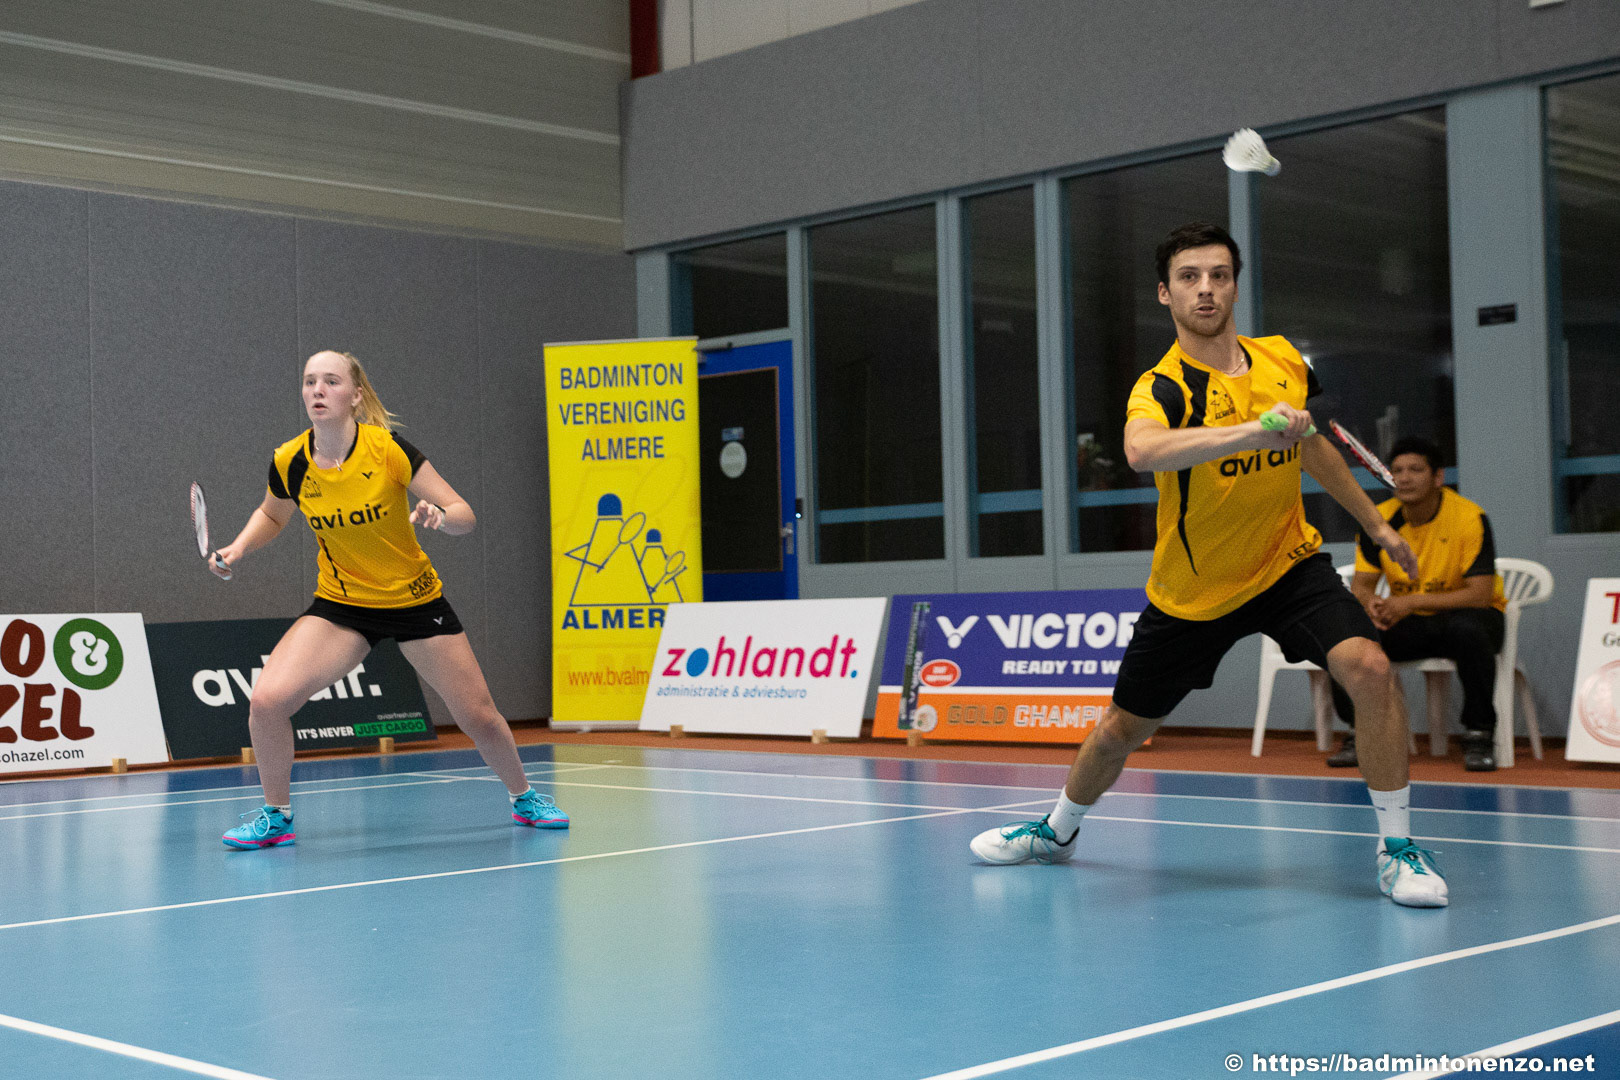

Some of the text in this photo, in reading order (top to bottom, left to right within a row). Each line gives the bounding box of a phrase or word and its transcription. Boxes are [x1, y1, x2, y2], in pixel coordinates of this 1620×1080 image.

[561, 363, 683, 389] BADMINTON
[559, 399, 685, 425] VERENIGING
[581, 436, 664, 461] ALMERE
[1220, 449, 1261, 477] avi
[309, 503, 388, 530] avi air.
[562, 608, 666, 630] ALMER
[986, 611, 1142, 649] VICTOR
[0, 618, 46, 678] O
[662, 634, 858, 678] zohlandt.
[568, 665, 650, 686] www.bvalm
[1002, 660, 1122, 675] READY TO W
[656, 684, 807, 699] administratie & adviesburo
[947, 705, 1110, 728] GOLD CHAMPI
[296, 721, 424, 740] IT'S NEVER JUST CARGO
[0, 748, 85, 763] ohazel.com
